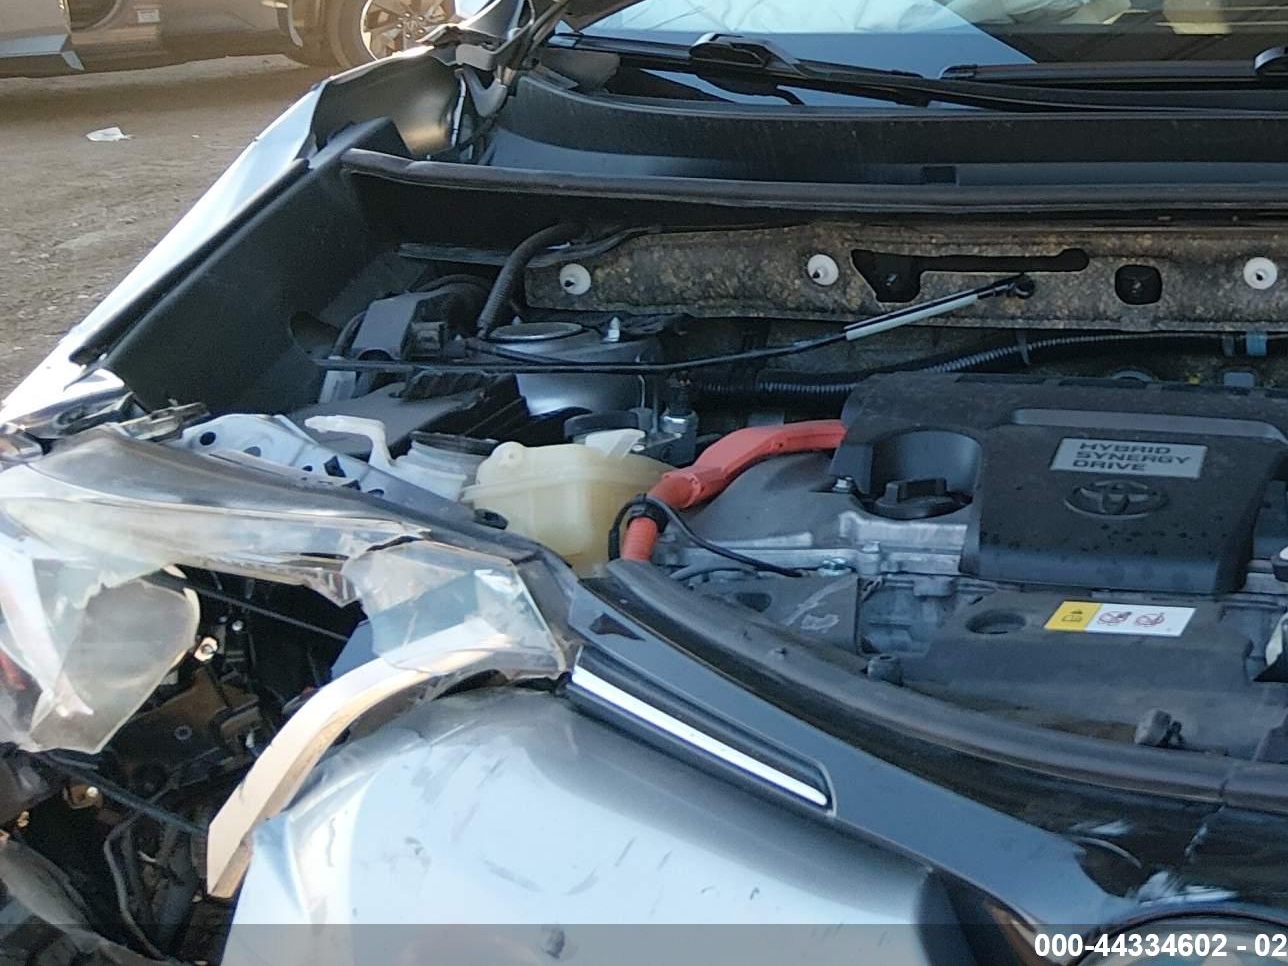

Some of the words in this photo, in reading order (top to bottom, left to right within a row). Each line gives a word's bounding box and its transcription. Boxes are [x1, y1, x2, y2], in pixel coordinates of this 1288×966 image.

[1080, 442, 1171, 454] HYBRID
[1076, 451, 1191, 464] SYNERGY
[1072, 459, 1145, 471] DRIVE
